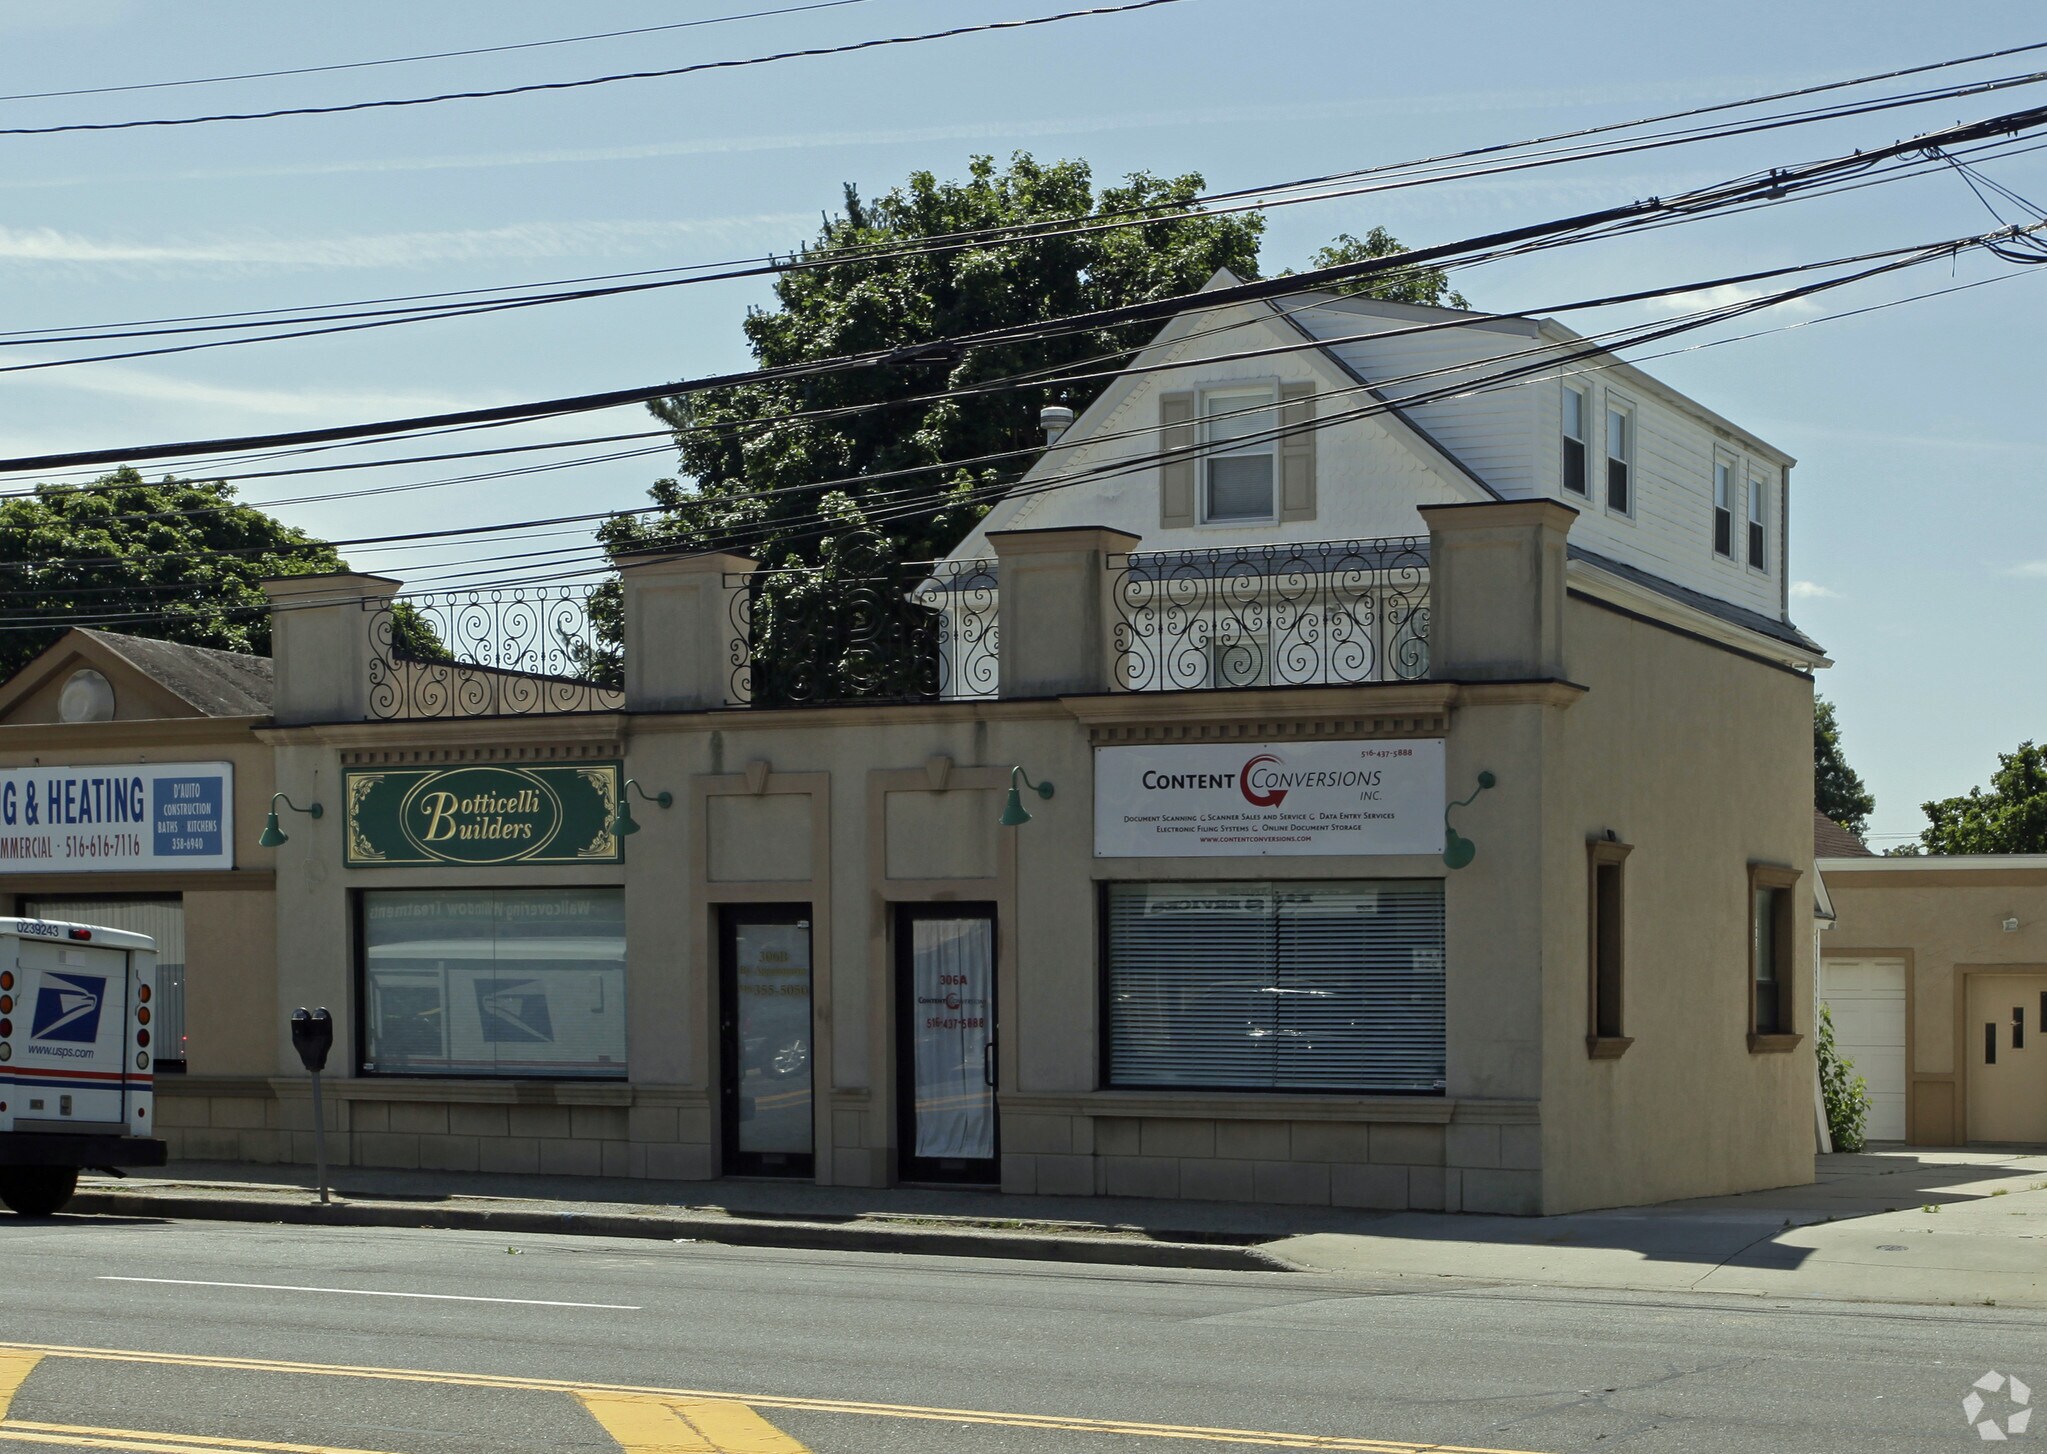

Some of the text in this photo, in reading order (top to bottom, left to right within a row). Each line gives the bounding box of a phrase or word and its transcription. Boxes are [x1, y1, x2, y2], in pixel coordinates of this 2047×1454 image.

[1361, 749, 1413, 759] 516-437-5888
[1142, 768, 1382, 790] CONTENT CONVERSIONS
[0, 777, 144, 825] G & HEATING
[1360, 791, 1382, 801] INC.
[163, 802, 212, 816] CONSTRUCTION
[1123, 815, 1160, 823] DOCUMENT
[1162, 814, 1197, 822] SCANNING
[1207, 813, 1239, 821] SCANNER
[1279, 812, 1306, 820] SERVICE
[1319, 812, 1337, 820] DATA
[1339, 812, 1361, 820] ENTRY
[1363, 812, 1395, 820] SERVICES
[157, 820, 217, 834] BATHS KITCHENS
[1156, 825, 1195, 833] ELECTRONIC
[1262, 824, 1288, 832] ONLINE
[1290, 823, 1328, 831] DOCUMENT
[1331, 823, 1362, 831] STORAGE
[66, 834, 140, 858] 516-616-7116
[172, 838, 203, 851] 358-6940
[16, 921, 59, 937] 0239243
[940, 975, 967, 985] 306A
[28, 1044, 94, 1059] www.usps.com
